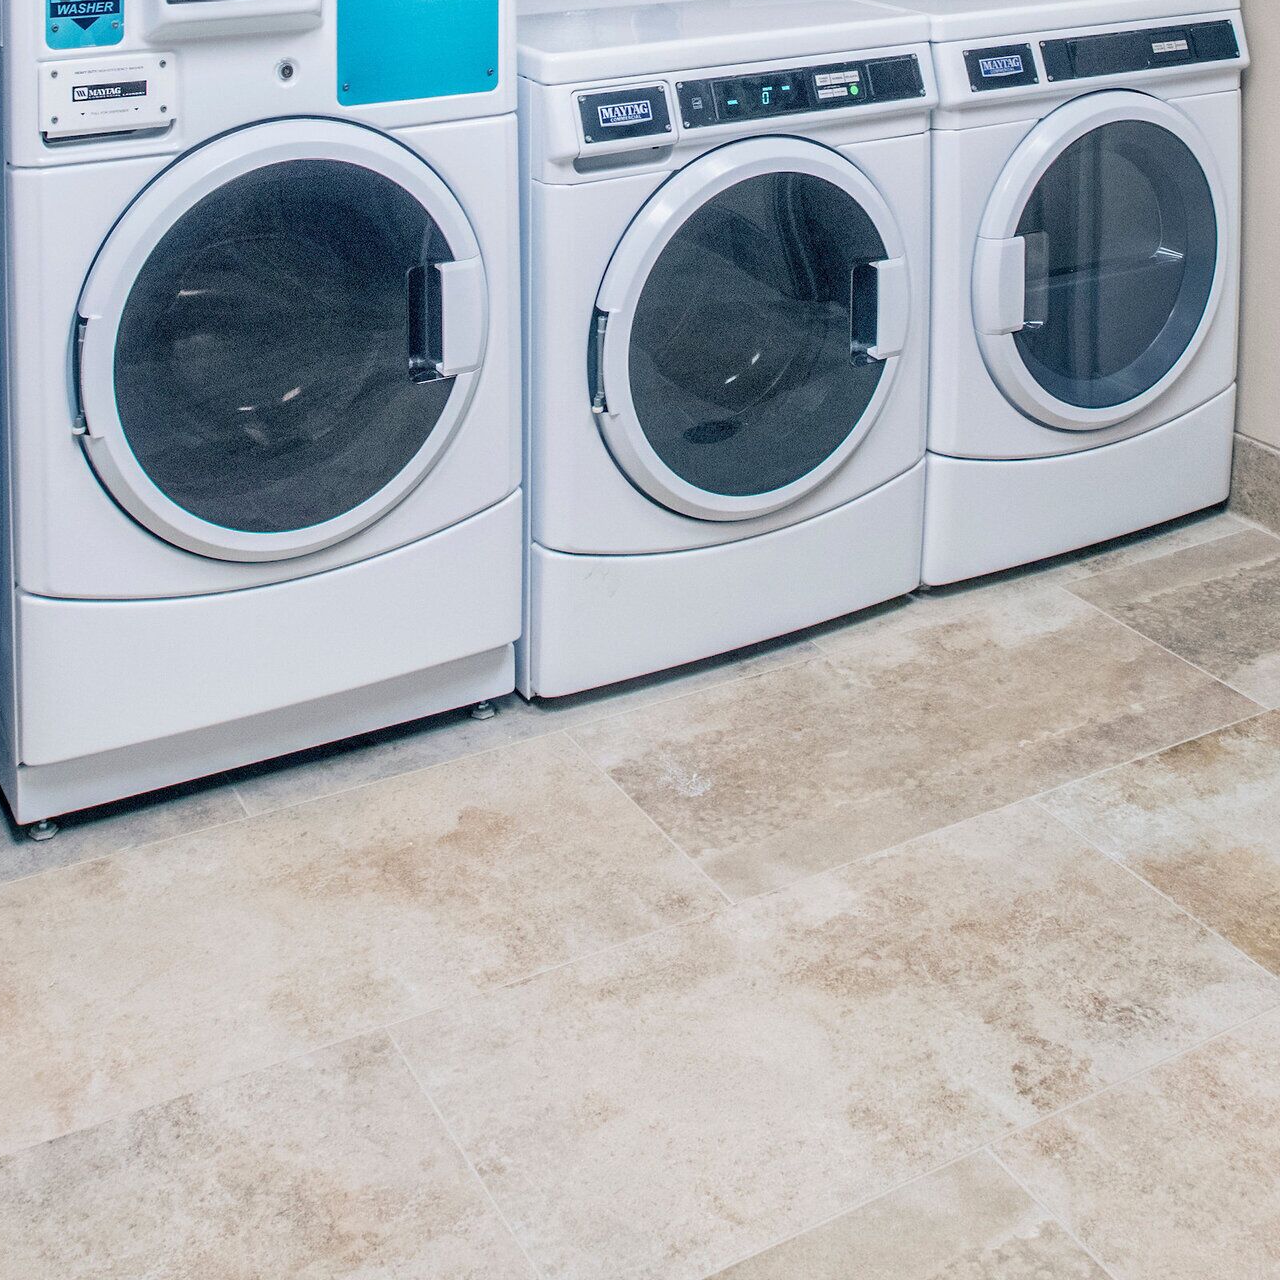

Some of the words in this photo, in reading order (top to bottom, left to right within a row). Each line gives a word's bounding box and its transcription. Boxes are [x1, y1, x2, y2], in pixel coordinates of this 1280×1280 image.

[57, 1, 114, 15] WASHER
[983, 58, 1020, 71] MAYTAG
[88, 87, 121, 97] MAYTAG
[762, 91, 770, 105] 0
[601, 103, 649, 119] MAYTAG
[610, 114, 642, 123] COMMERCIAL
